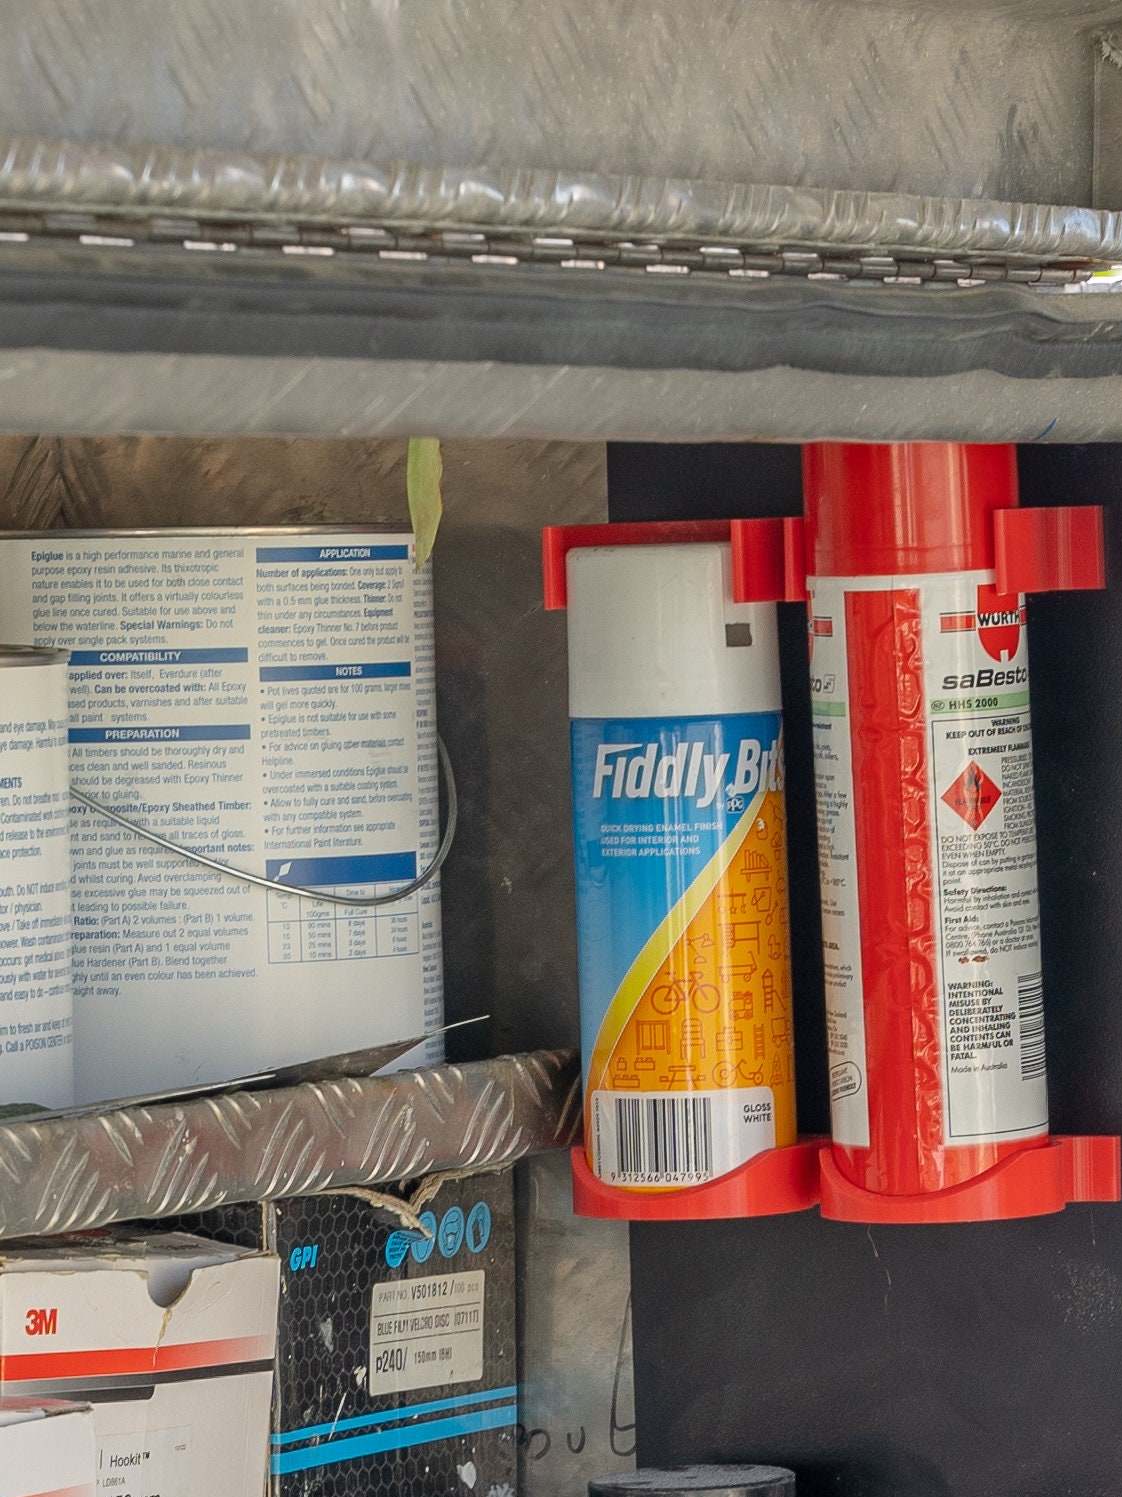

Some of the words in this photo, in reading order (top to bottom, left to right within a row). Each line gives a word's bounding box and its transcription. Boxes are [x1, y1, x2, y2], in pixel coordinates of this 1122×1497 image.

[32, 551, 63, 561] Epiglue
[66, 552, 73, 560] is
[83, 551, 100, 561] high
[104, 550, 159, 561] performance
[162, 550, 191, 559] marine
[194, 549, 210, 558] and
[213, 549, 244, 559] general
[320, 549, 370, 558] APPLICATION
[257, 569, 289, 578] Number
[291, 568, 299, 577] of
[33, 621, 57, 632] below
[60, 621, 73, 630] the
[120, 620, 154, 631] Special
[158, 620, 203, 630] Warnings:
[206, 619, 217, 629] Do
[220, 619, 233, 628] not
[100, 651, 181, 662] COMPATIBILITY
[336, 667, 362, 676] NOTES
[942, 666, 1027, 690] saBesto
[94, 684, 112, 694] Can
[114, 684, 126, 693] be
[129, 683, 180, 693] overcoated
[208, 682, 219, 692] All
[222, 681, 246, 692] Epoxy
[949, 699, 972, 710] HHS
[975, 697, 999, 708] 2000
[105, 729, 179, 739] PREPARATION
[946, 731, 966, 739] KEEP
[968, 729, 985, 738] OUT
[987, 728, 996, 736] OF
[998, 727, 1015, 735] REACH
[968, 745, 1006, 755] EXTREMELY
[593, 742, 730, 809] Fiddly
[623, 824, 654, 832] DRYING
[656, 823, 693, 832] ENAMEL
[695, 822, 723, 831] FINISH
[638, 835, 678, 844] INTERIOR
[681, 835, 699, 843] AND
[602, 848, 636, 856] EXTERIOR
[638, 847, 701, 856] APPLICATIONS
[944, 887, 969, 897] Safety
[948, 988, 1003, 999] INTENTIONAL
[949, 999, 979, 1008] MISUSE
[949, 1005, 1003, 1016] DELIBERATELY
[949, 1012, 1016, 1025] CONCENTRATING
[950, 1026, 969, 1034] AND
[972, 1022, 1011, 1032] INHALING
[950, 1032, 994, 1042] CONTENTS
[996, 1031, 1011, 1039] CAN
[963, 1041, 1001, 1050] HARMFUL
[1003, 1039, 1013, 1047] OR
[951, 1066, 971, 1074] Made
[981, 1062, 1008, 1070] Australia
[743, 1103, 771, 1112] GLOSS
[743, 1113, 772, 1123] WHITE
[290, 1244, 319, 1271] GPI
[411, 1282, 448, 1299] V501812
[25, 1308, 58, 1336] 3M
[377, 1320, 393, 1336] BLUE
[435, 1314, 450, 1328] DISC
[414, 1350, 437, 1364] 150mm
